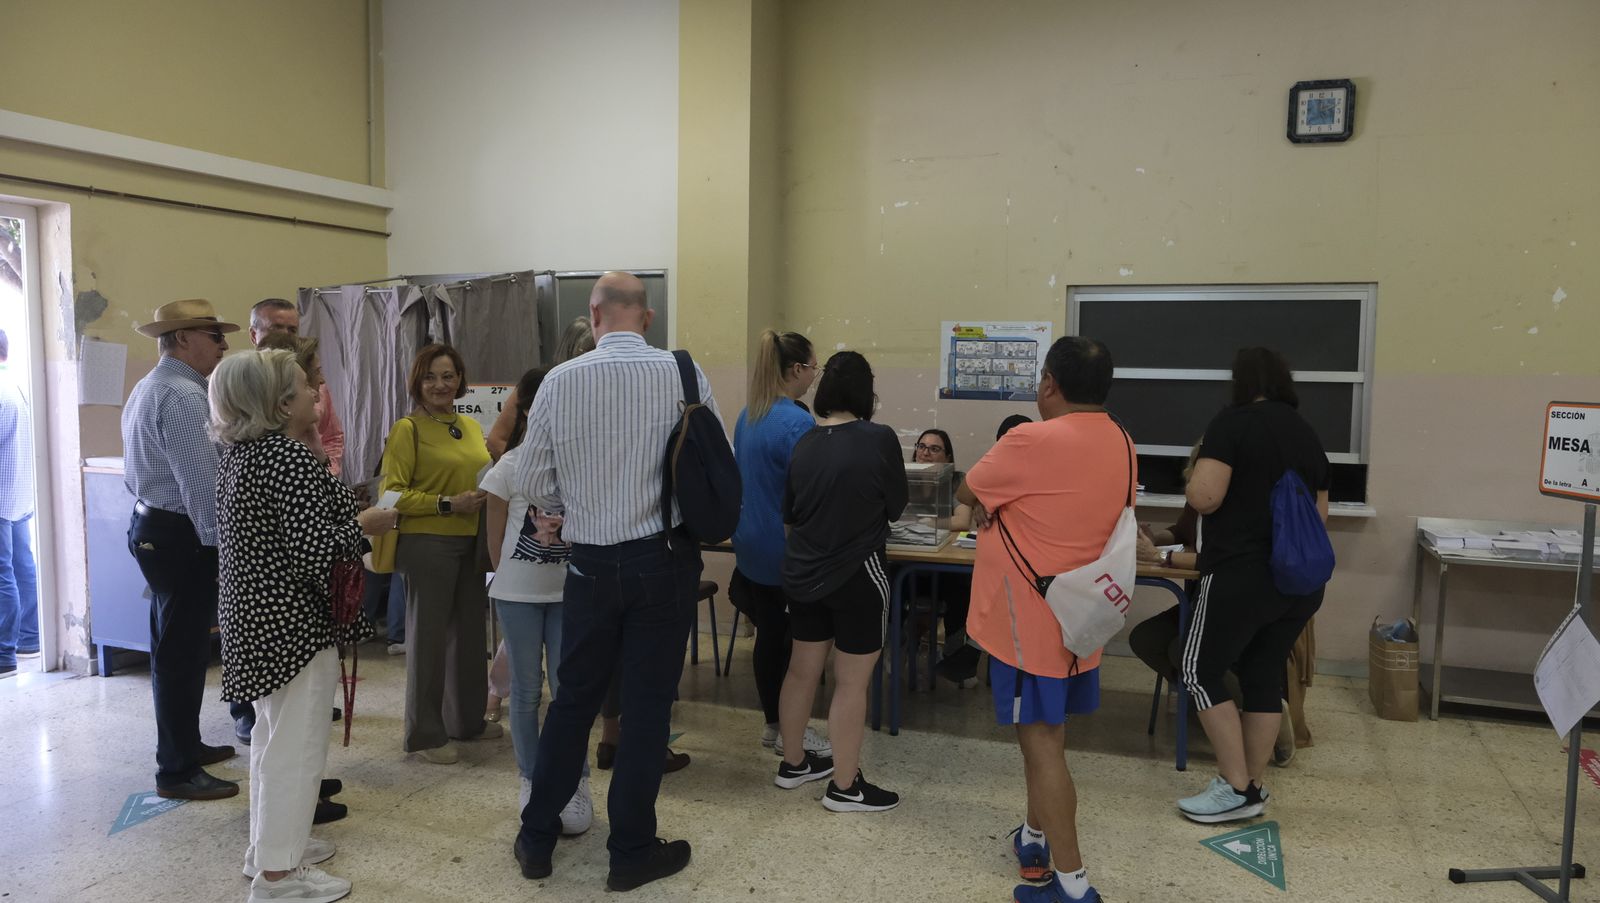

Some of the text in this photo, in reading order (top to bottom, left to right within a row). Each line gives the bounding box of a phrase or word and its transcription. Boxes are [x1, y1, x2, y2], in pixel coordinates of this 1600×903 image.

[1551, 411, 1585, 420] SECCIÓN
[1548, 436, 1591, 453] MESA
[1558, 480, 1572, 488] letra
[1581, 478, 1588, 487] A
